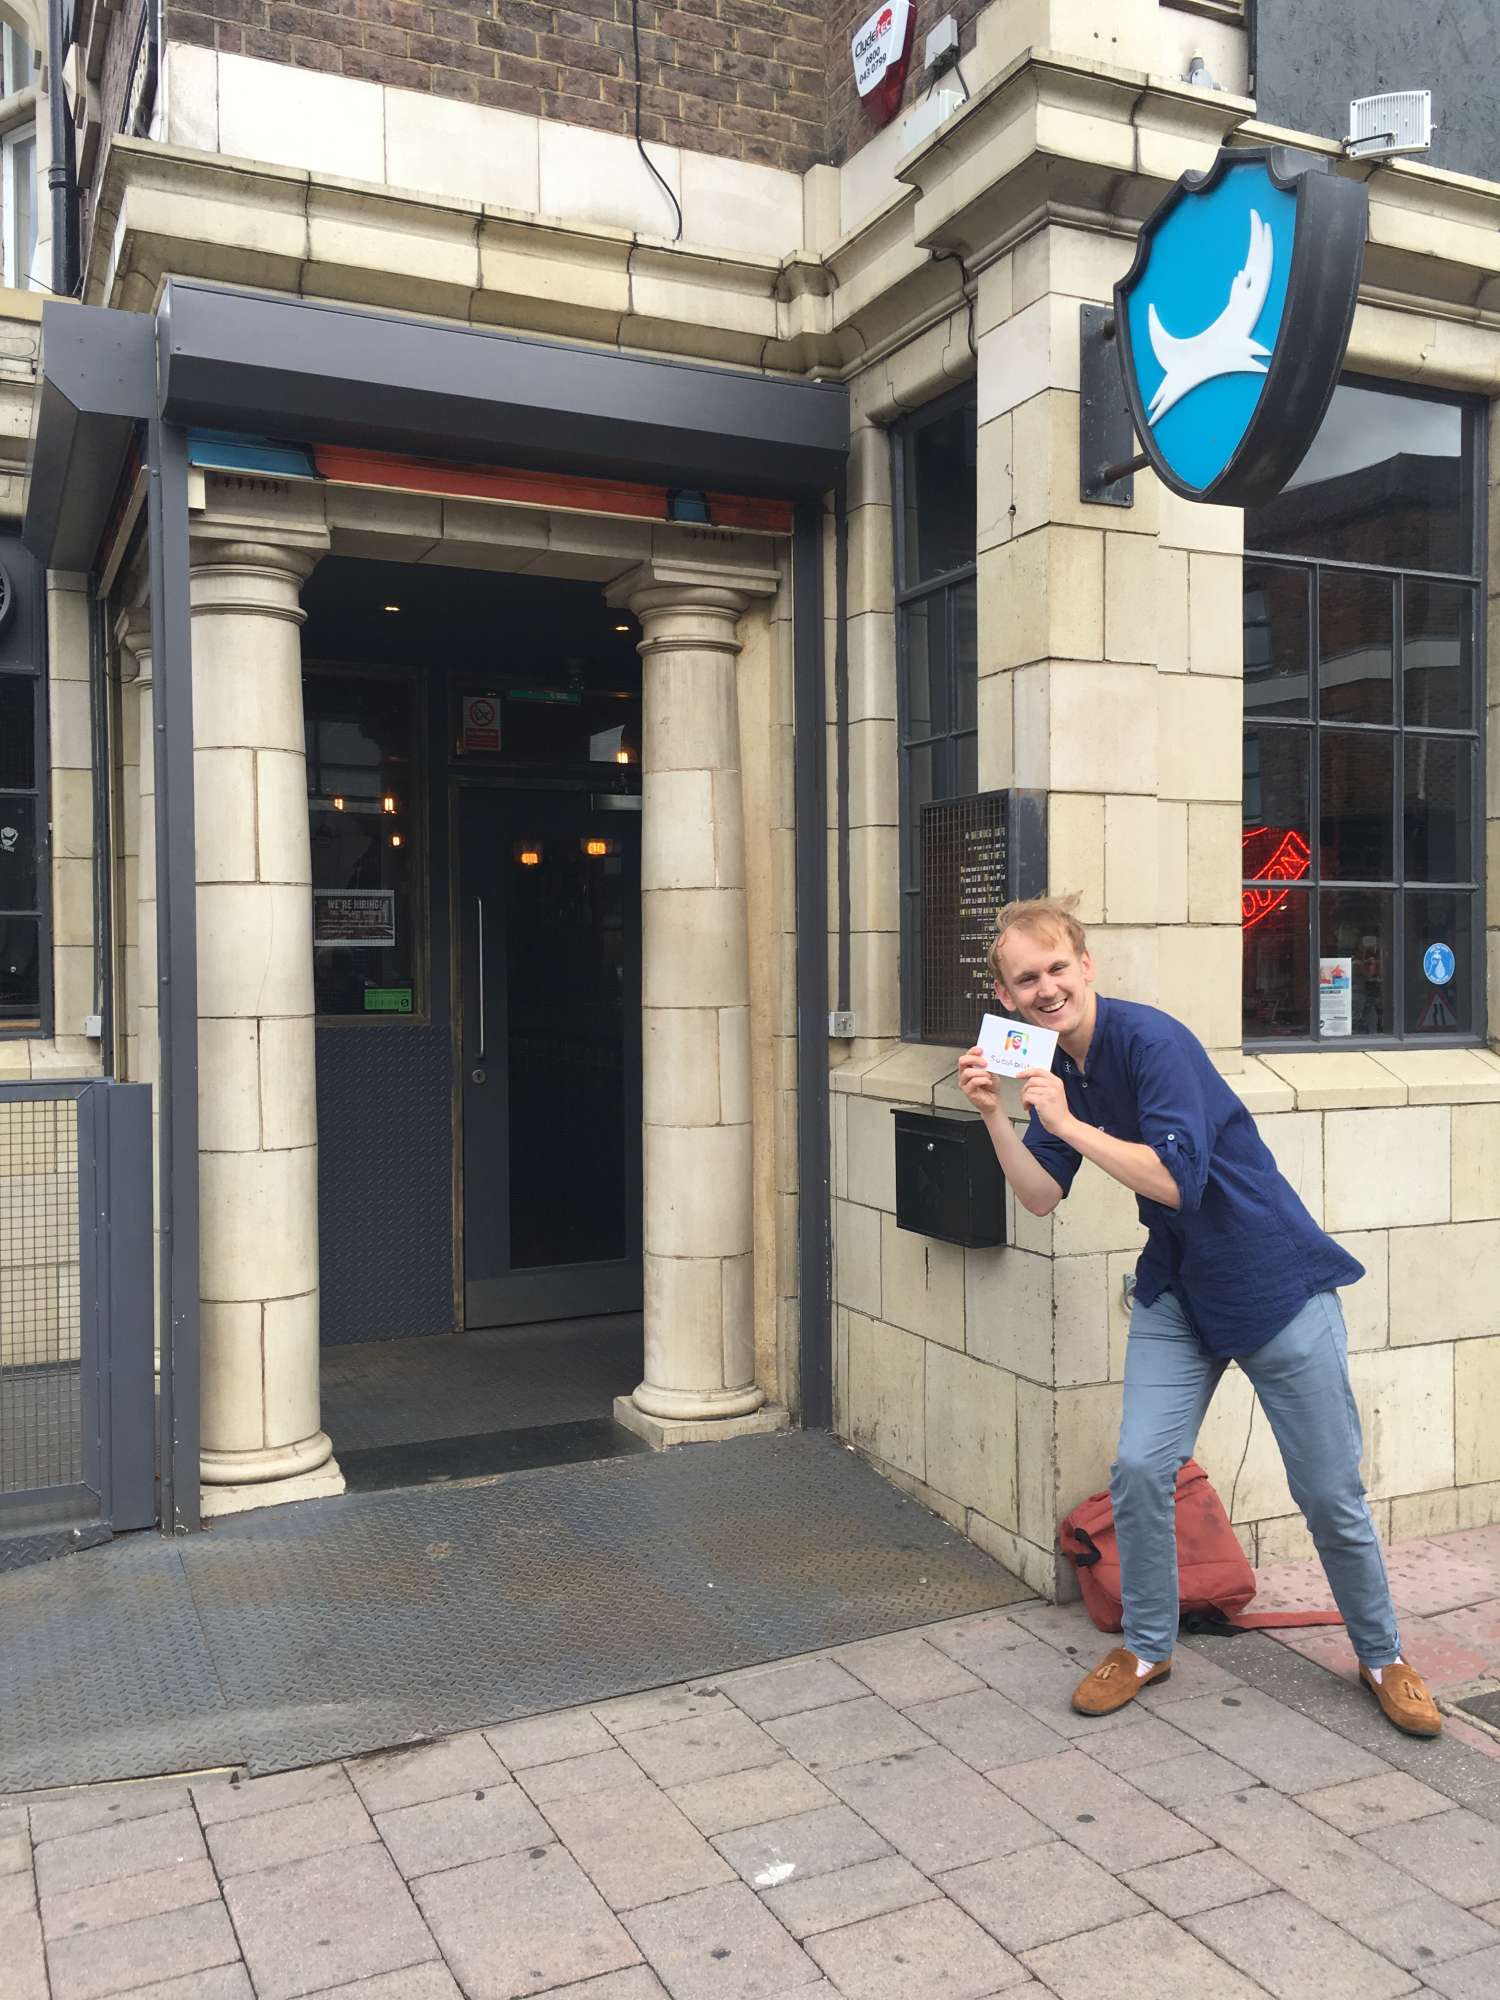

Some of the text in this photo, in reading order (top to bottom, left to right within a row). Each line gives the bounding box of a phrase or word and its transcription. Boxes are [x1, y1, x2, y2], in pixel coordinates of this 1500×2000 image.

[860, 53, 887, 85] 043 0799
[865, 46, 881, 67] 0800
